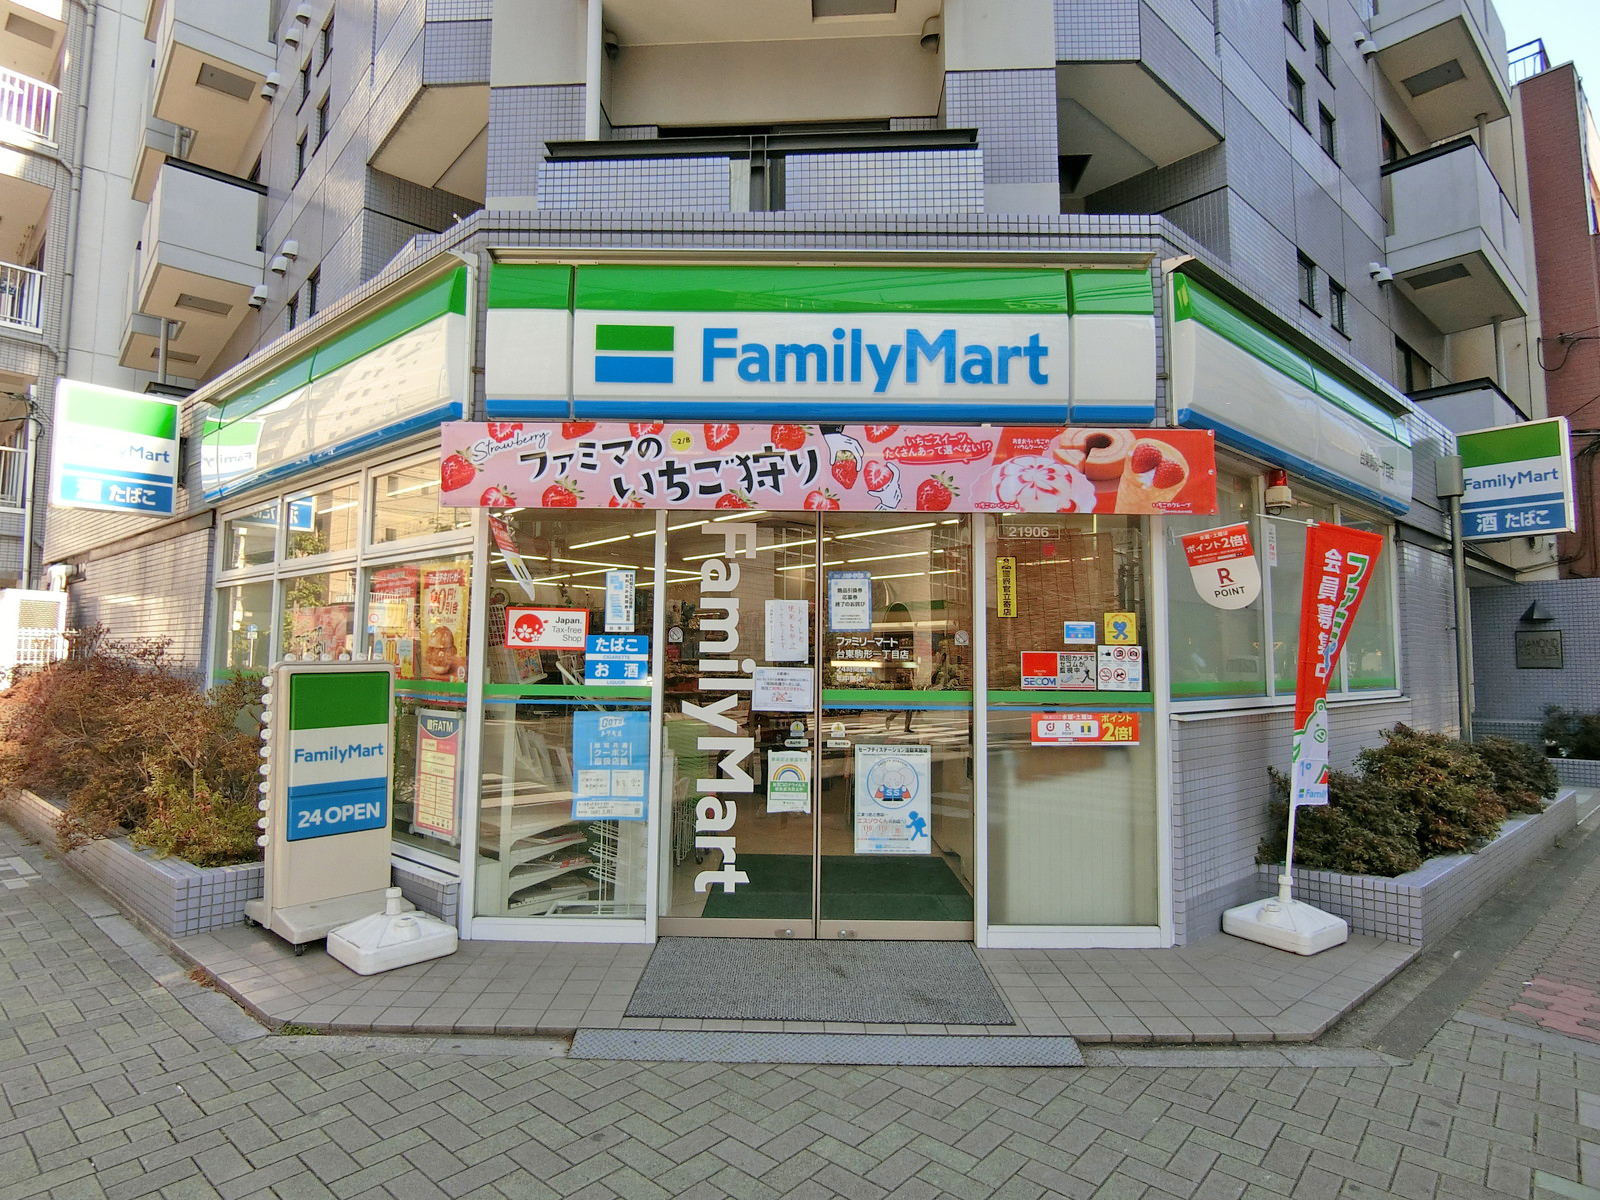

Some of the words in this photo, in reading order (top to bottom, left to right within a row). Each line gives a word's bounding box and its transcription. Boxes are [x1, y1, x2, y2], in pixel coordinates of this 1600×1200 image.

[701, 326, 1049, 393] FamilyMart
[472, 431, 550, 462] Strawberry
[906, 433, 972, 447] いちごスイーツ、
[519, 437, 663, 480] ファミマの
[613, 446, 818, 502] いちご狩り
[1463, 468, 1559, 491] FamilyMart
[108, 483, 156, 506] たばこ
[1476, 512, 1498, 533] 酒
[1504, 509, 1551, 529] たばこ
[1008, 526, 1050, 538] 21906
[1216, 567, 1235, 588] R
[1214, 586, 1245, 598] POINT
[551, 625, 583, 634] Tax-free
[562, 634, 582, 643] Shop
[595, 637, 639, 652] たばこ
[836, 636, 899, 647] ファミリーマート
[836, 649, 909, 660] 台東駒形一丁目店
[1023, 677, 1057, 686] SECOM
[681, 522, 757, 893] FamilyMart
[426, 718, 453, 733] 銀行ATM
[1101, 714, 1133, 722] ポイント
[1101, 722, 1133, 741] 2倍!
[293, 742, 384, 764] FamilyMart
